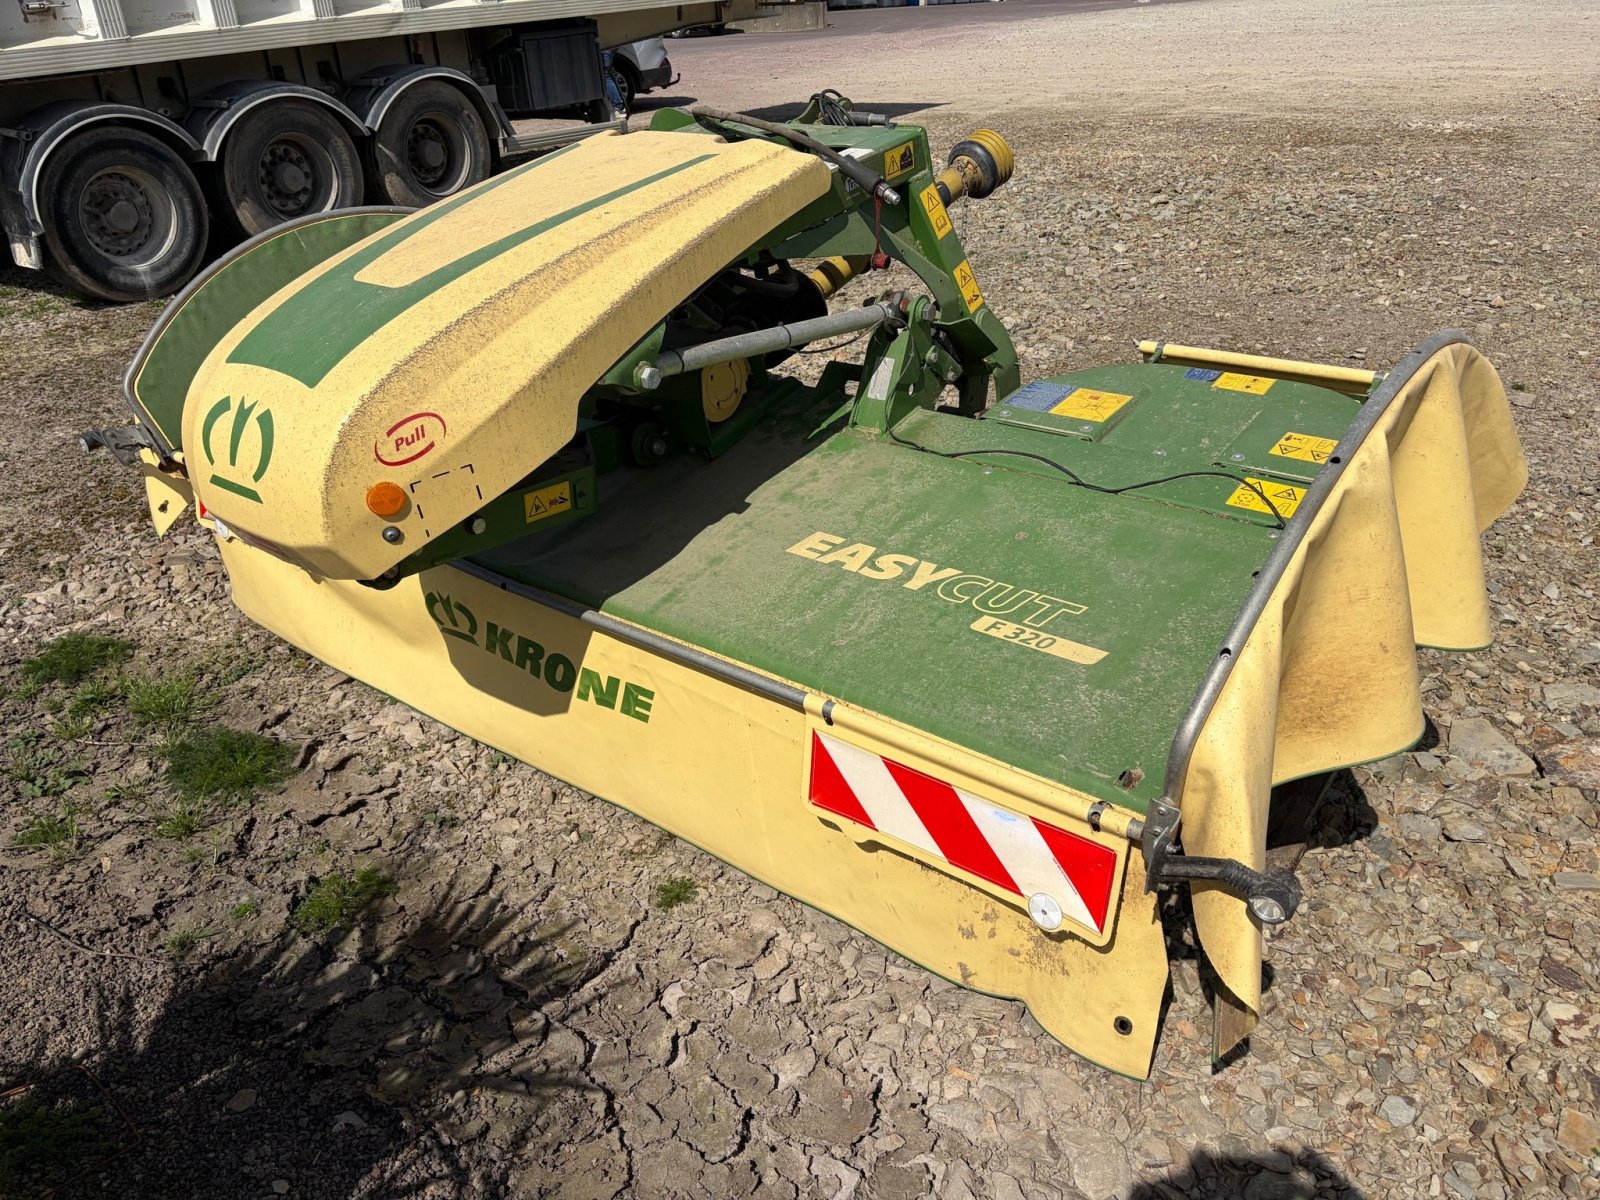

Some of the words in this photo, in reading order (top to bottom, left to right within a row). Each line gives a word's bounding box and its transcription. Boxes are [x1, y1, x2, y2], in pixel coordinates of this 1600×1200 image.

[394, 424, 426, 452] Pull
[785, 531, 1089, 628] EASYCUT
[983, 620, 1002, 634] F
[1003, 625, 1057, 651] 320
[485, 621, 656, 724] KRONE
